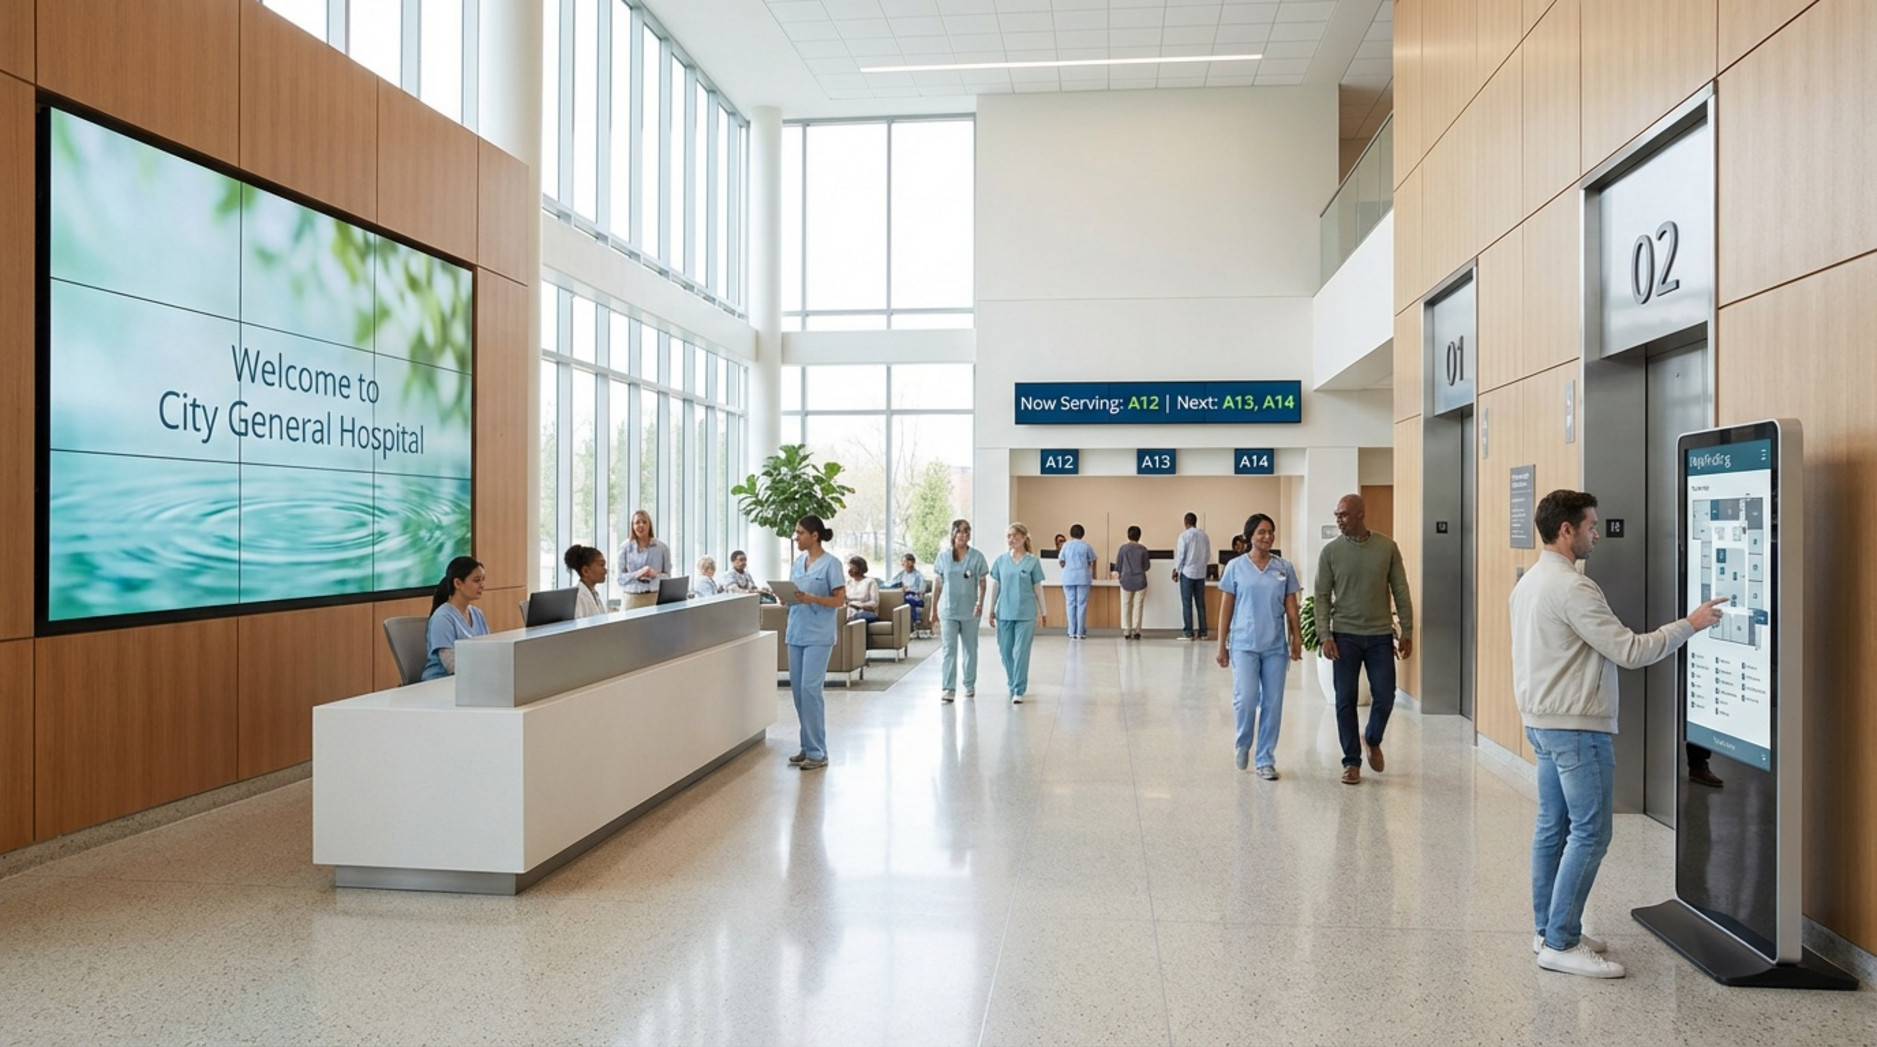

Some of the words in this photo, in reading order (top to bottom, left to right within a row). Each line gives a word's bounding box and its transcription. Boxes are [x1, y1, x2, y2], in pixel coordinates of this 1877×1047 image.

[1631, 220, 1680, 304] 02
[231, 345, 351, 399] Welcome
[358, 373, 380, 404] to
[1446, 335, 1464, 386] 01
[1021, 396, 1057, 411] Now
[1060, 395, 1124, 414] Serving:
[1127, 396, 1159, 410] A12
[1177, 395, 1218, 410] Next:
[1222, 395, 1258, 412] A13,
[1262, 395, 1295, 409] A14
[159, 391, 218, 444] City
[228, 401, 331, 445] General
[340, 415, 424, 460] Hospital
[1045, 455, 1074, 469] A12
[1142, 455, 1171, 469] A13
[1239, 455, 1268, 469] A14
